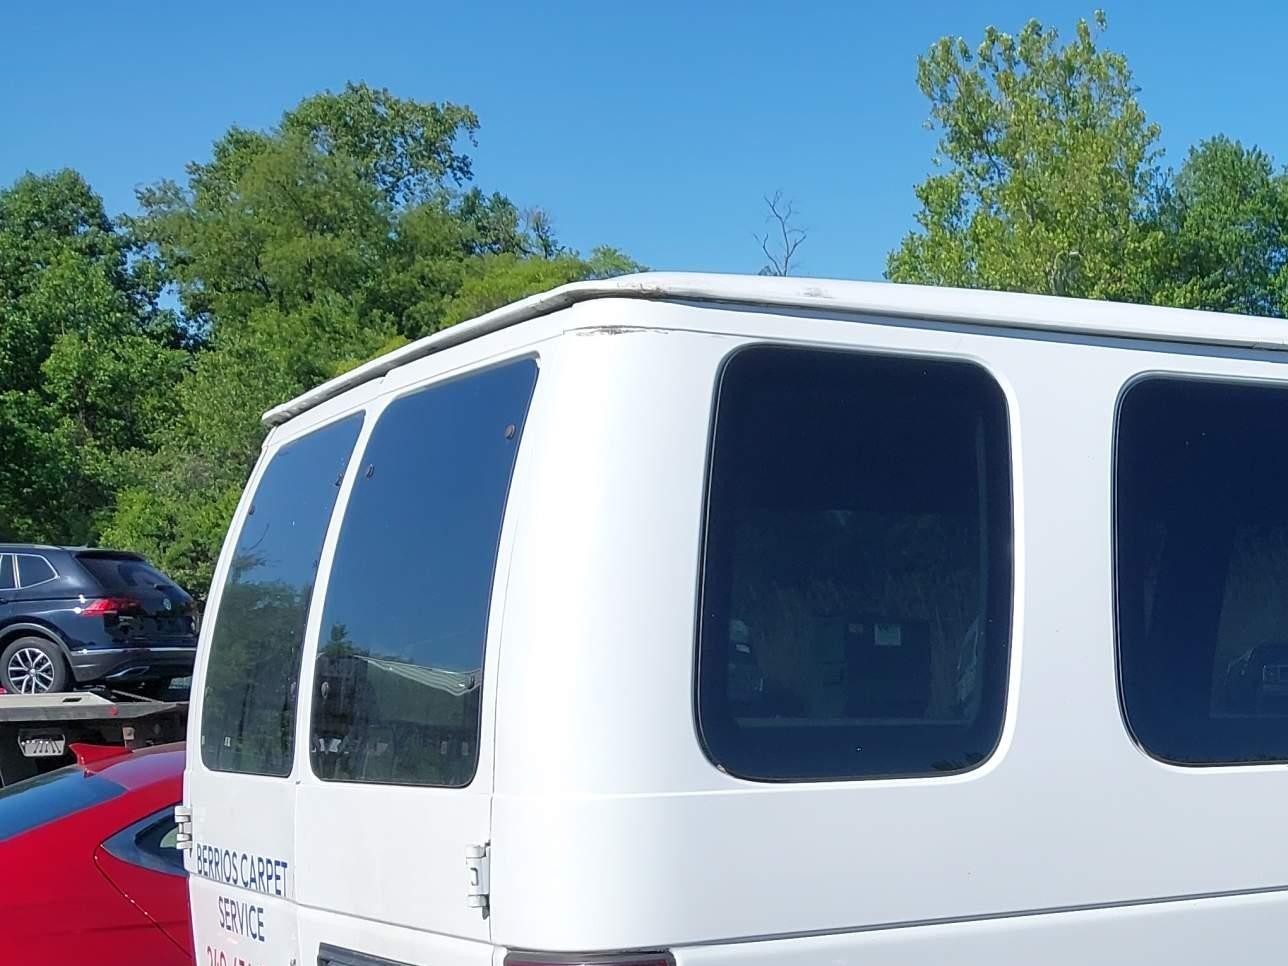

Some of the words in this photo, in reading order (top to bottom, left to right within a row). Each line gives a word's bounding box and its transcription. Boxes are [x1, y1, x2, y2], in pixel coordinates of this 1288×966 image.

[196, 843, 238, 885] BERRIOS
[240, 853, 288, 896] CARPET
[218, 896, 265, 942] SERVICE
